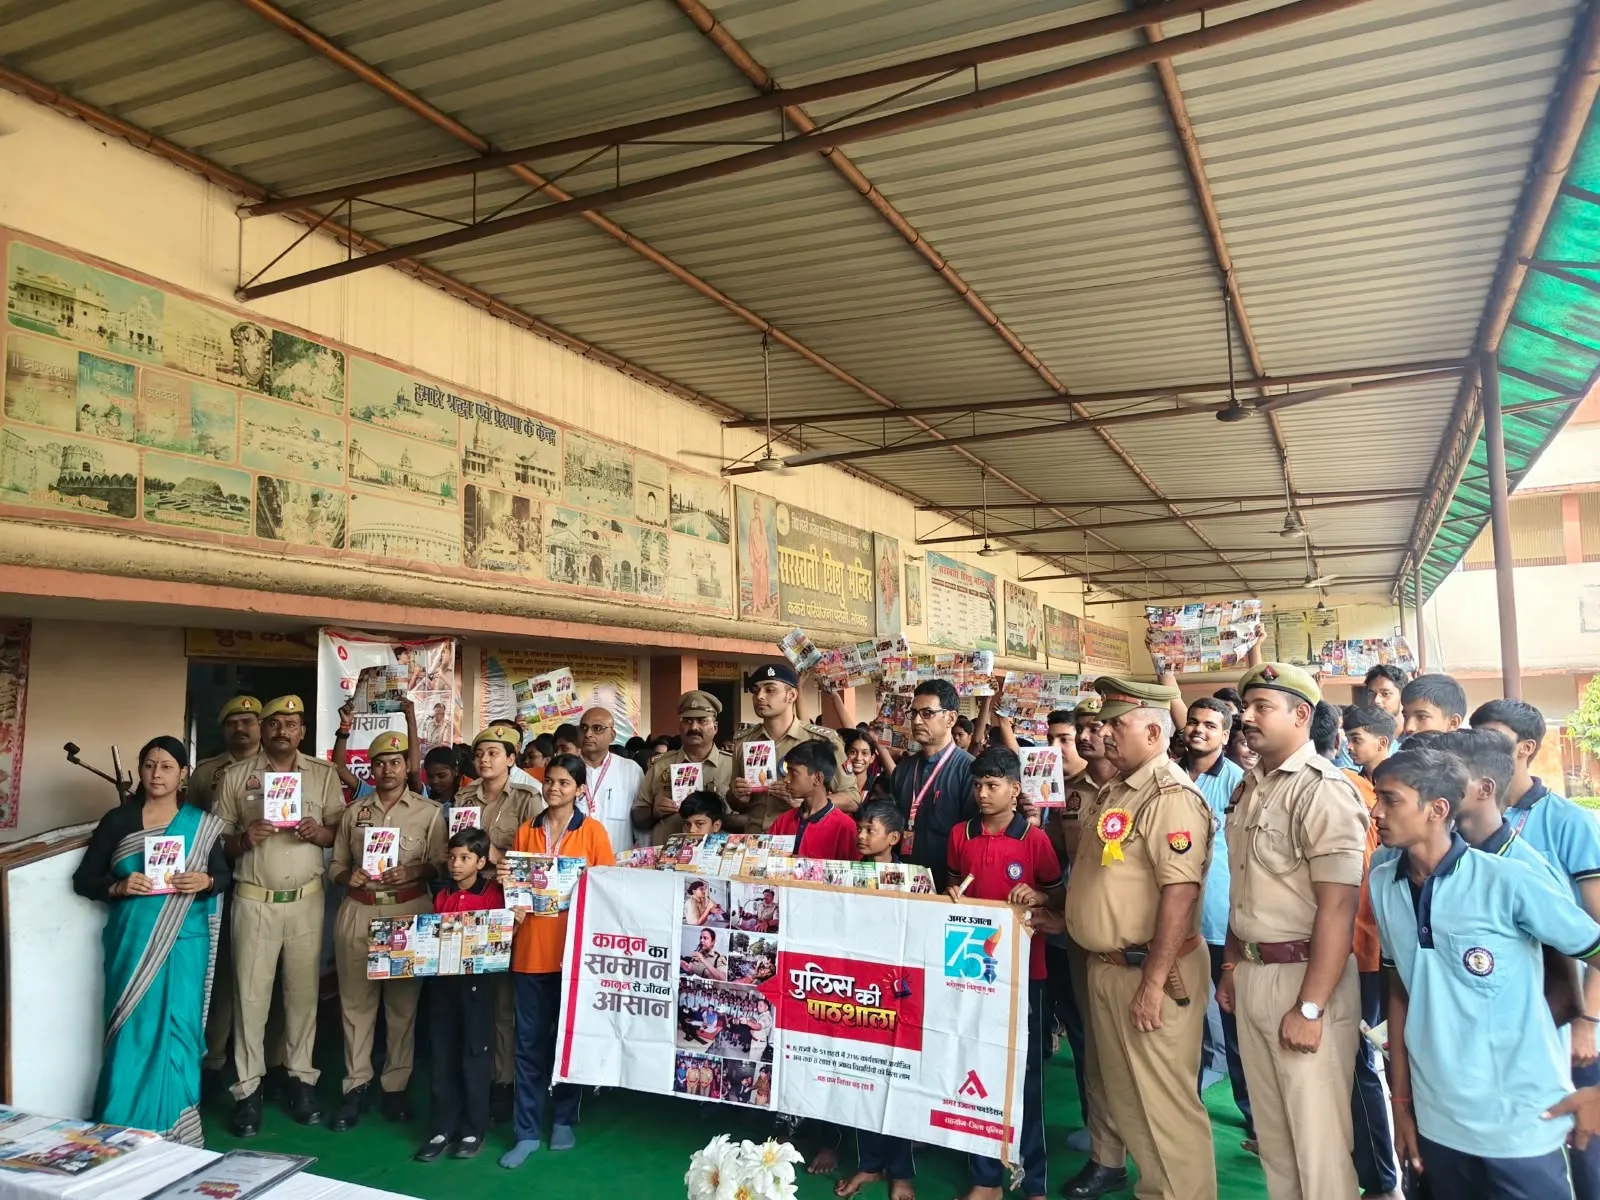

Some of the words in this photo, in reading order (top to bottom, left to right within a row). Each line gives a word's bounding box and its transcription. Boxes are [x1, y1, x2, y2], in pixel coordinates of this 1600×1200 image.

[414, 382, 445, 409] हमारे
[475, 401, 493, 425] एवं
[493, 405, 523, 434] प्रेरणा
[523, 416, 534, 437] के
[777, 543, 820, 591] सरस्वती
[822, 549, 847, 609] शिशु
[847, 556, 873, 602] मन्दिर
[948, 915, 966, 923] अमर
[967, 916, 992, 926] उजाला
[592, 932, 647, 955] कानून
[648, 945, 669, 959] का
[945, 925, 985, 979] 75
[584, 953, 671, 982] सम्मान
[600, 979, 630, 991] कानून
[632, 980, 641, 992] से
[643, 982, 670, 996] जीवन
[789, 962, 855, 999] पुलिस
[855, 983, 882, 1007] की
[592, 991, 672, 1018] आसान
[807, 999, 896, 1031] पाठशाला
[870, 1083, 874, 1091] है
[886, 1069, 898, 1078] मिला
[942, 1098, 956, 1106] अमर
[957, 1101, 976, 1110] उजाला
[986, 1125, 1004, 1135] पुलिस
